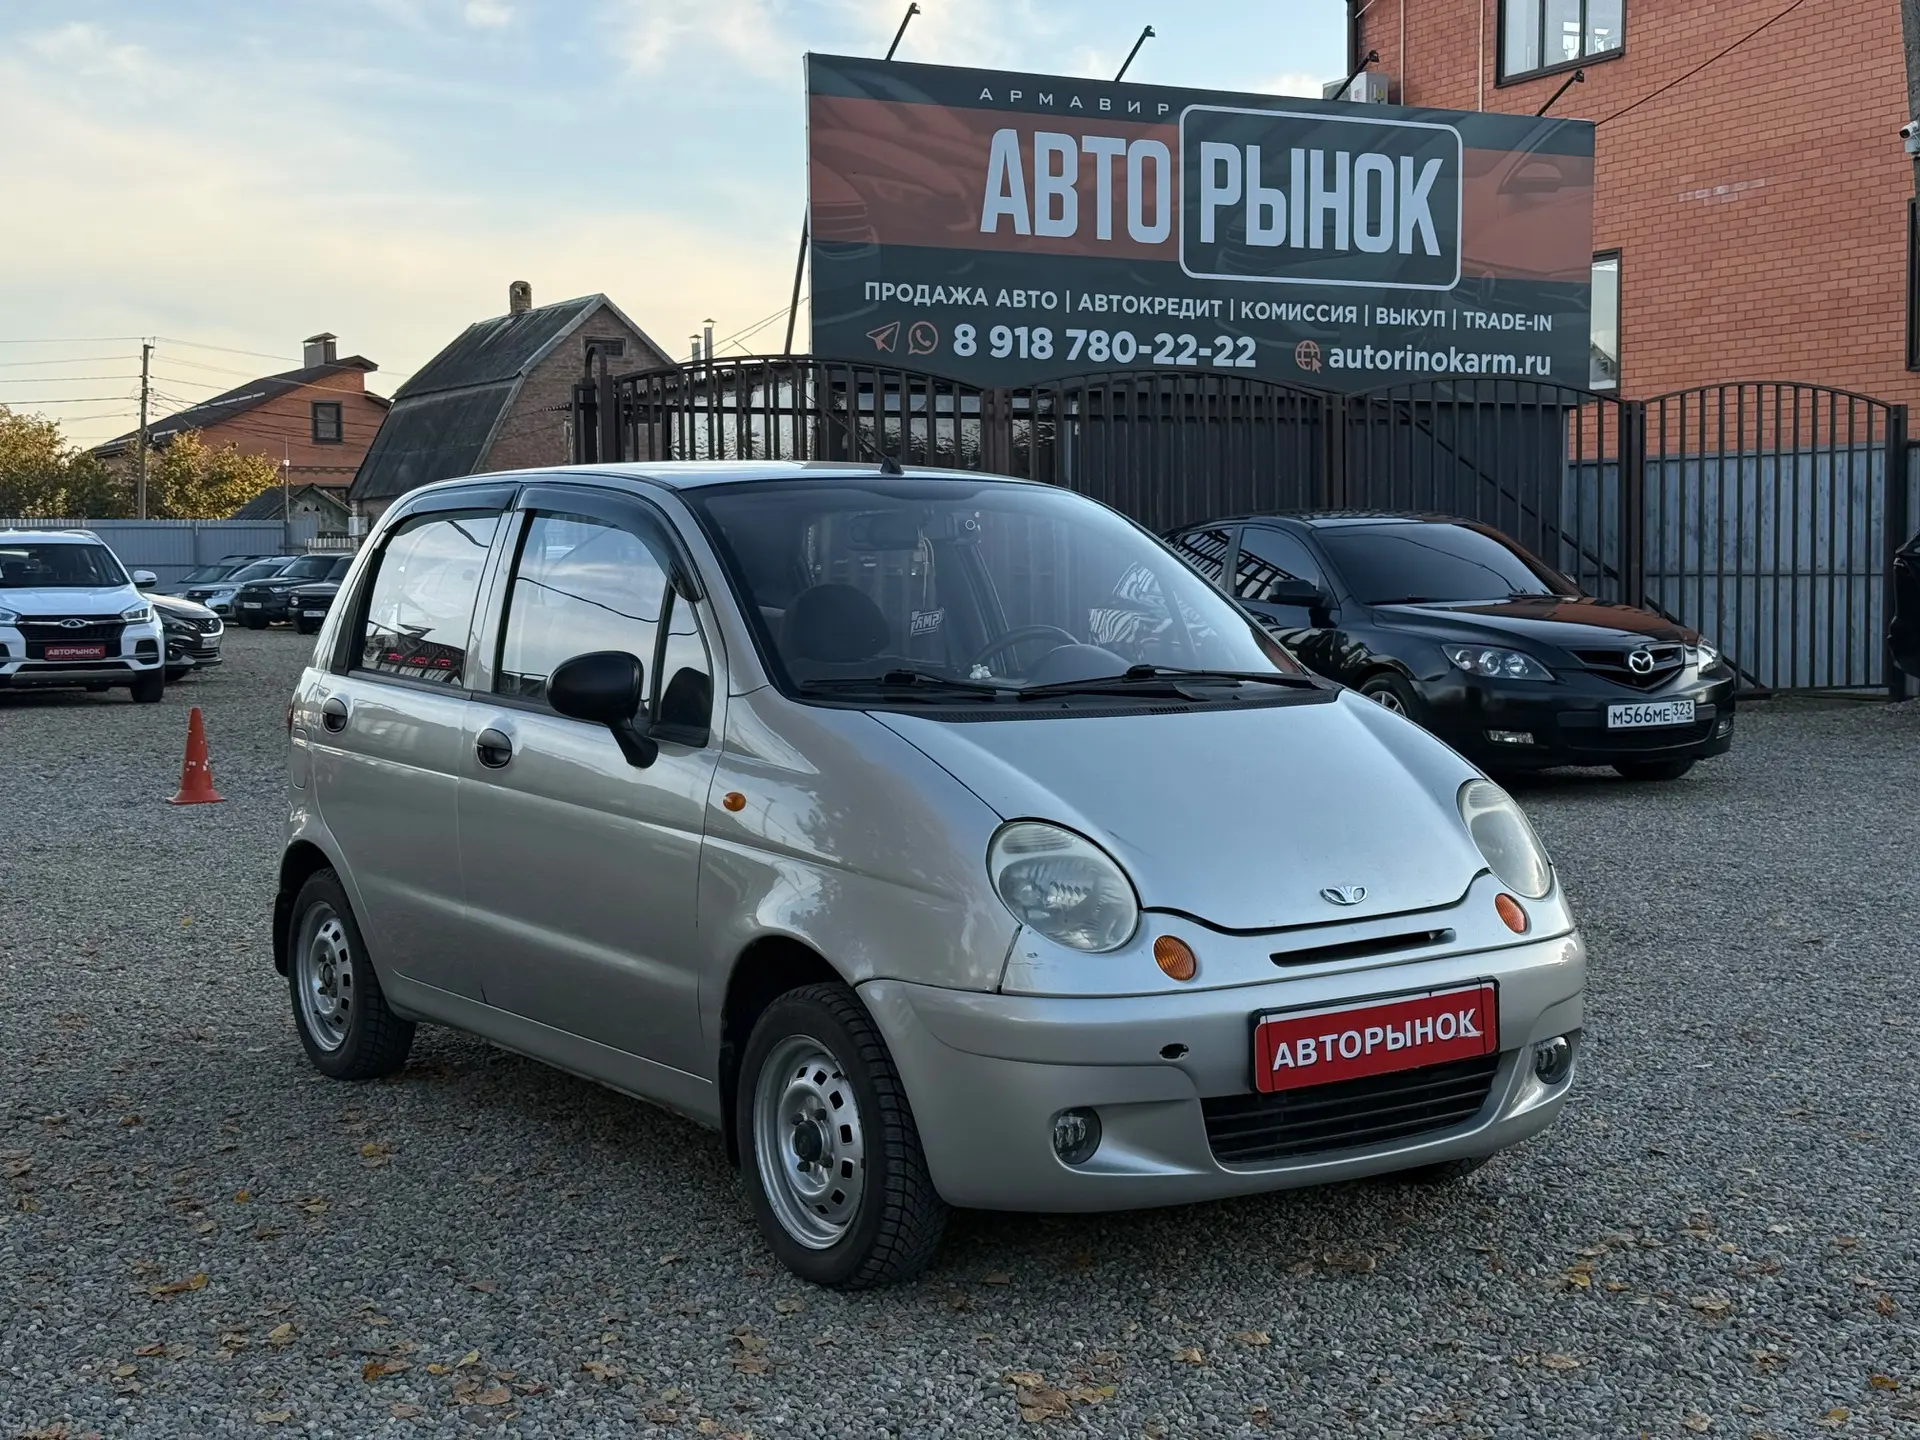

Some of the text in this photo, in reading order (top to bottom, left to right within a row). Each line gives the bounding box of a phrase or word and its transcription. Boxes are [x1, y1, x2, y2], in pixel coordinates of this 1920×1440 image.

[980, 88, 1170, 116] АРМАВИР
[865, 281, 1552, 332] ПРОДАЖА АВТО АВТОКРЕДИТ КОМИССИЯ ВЫКУП TRADE-IN
[953, 323, 1257, 368] 8 918 780-22-22
[1328, 344, 1552, 376] autorinokarm.ru
[47, 648, 101, 656] АВТОРЫНОК
[1673, 702, 1693, 715] 323
[1273, 1008, 1477, 1071] АВТОРЫНОК
